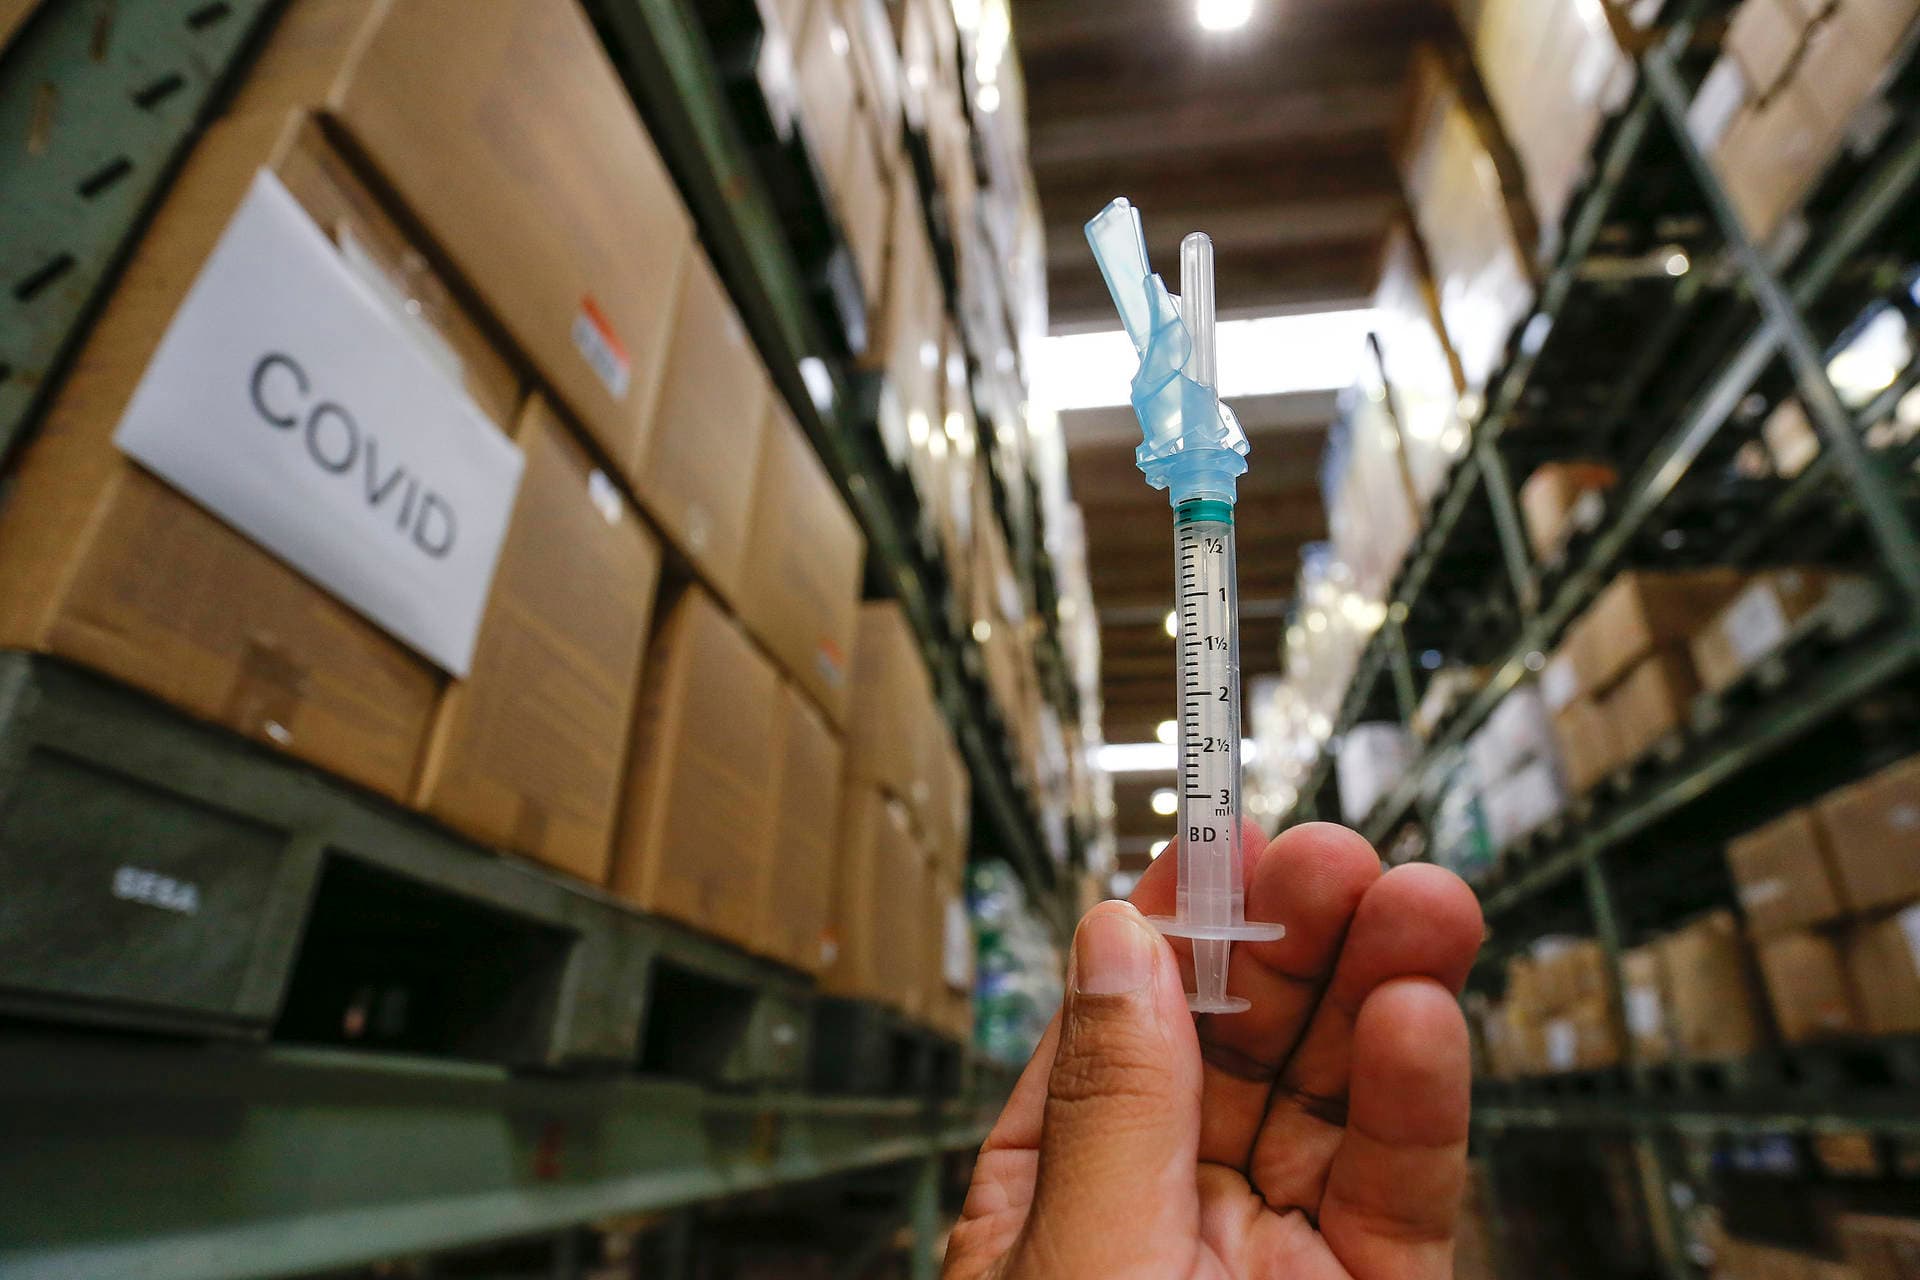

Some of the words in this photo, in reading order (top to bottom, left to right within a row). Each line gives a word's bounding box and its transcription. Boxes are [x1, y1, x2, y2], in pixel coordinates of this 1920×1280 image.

[250, 352, 458, 560] COVID
[1218, 587, 1226, 602] 1
[1218, 686, 1229, 702] 2
[1220, 789, 1230, 805] 3
[1190, 826, 1216, 842] BD
